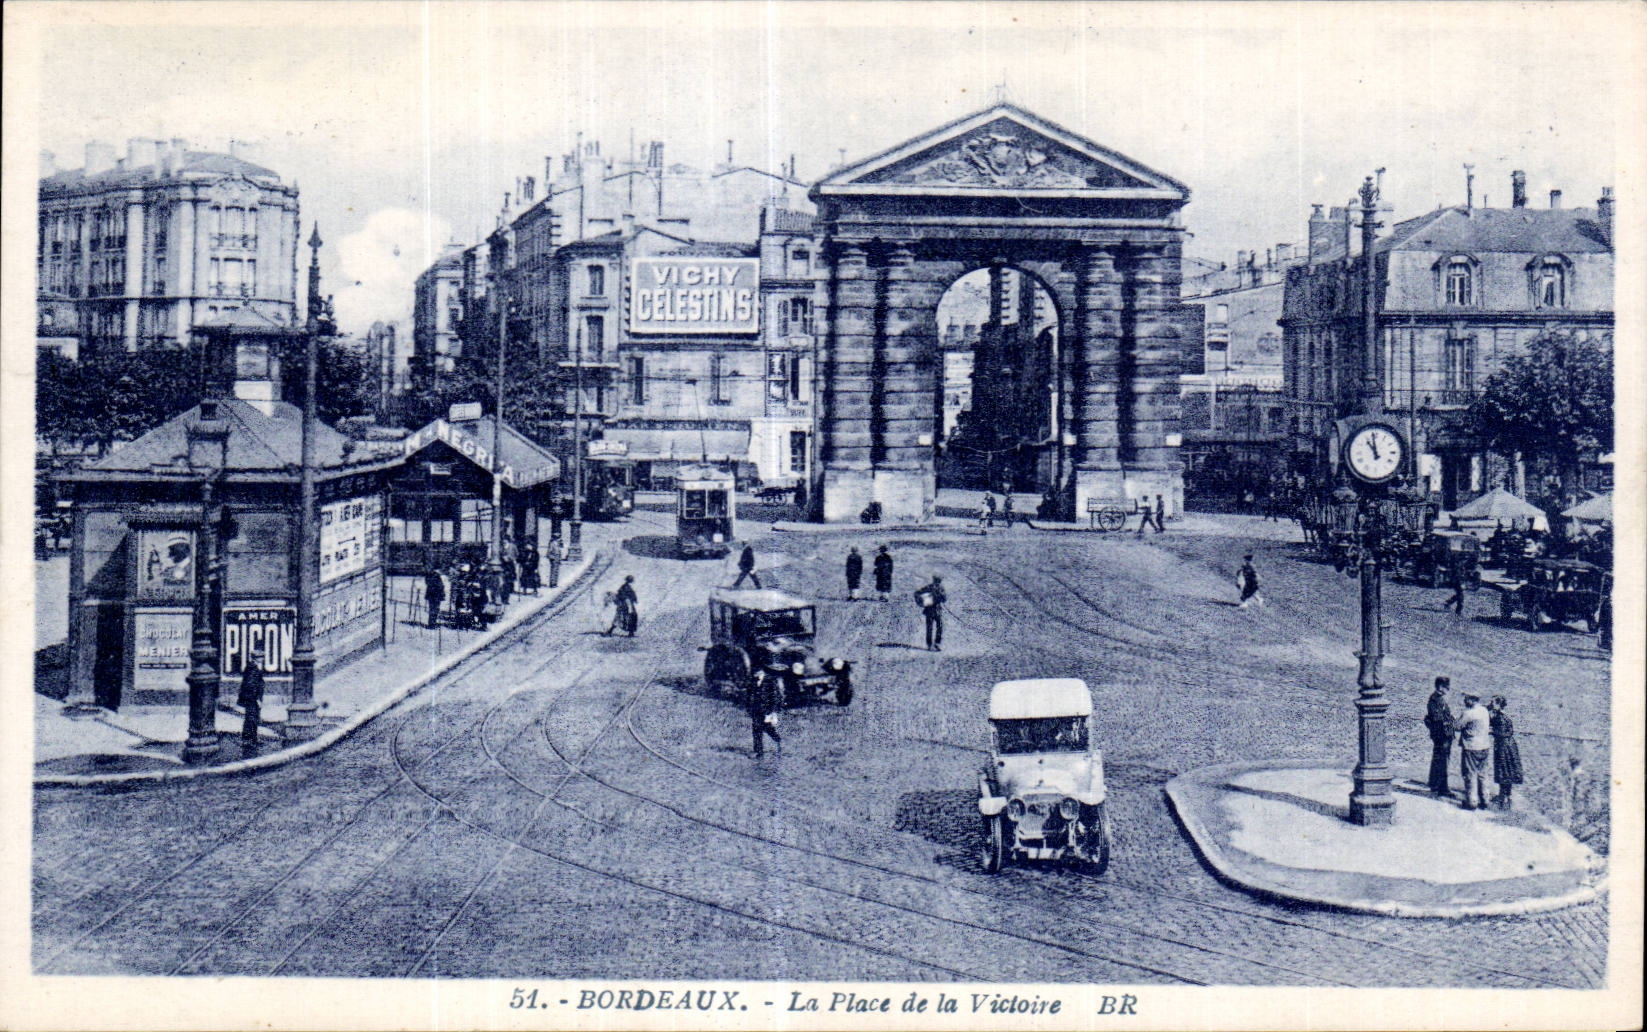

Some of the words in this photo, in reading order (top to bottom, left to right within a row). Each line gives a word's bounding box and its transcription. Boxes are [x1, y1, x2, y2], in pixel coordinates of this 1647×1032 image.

[653, 266, 740, 286] VICHY
[437, 419, 515, 485] NEGRIA
[238, 612, 278, 621] AMER
[138, 646, 190, 659] MENIER
[225, 623, 294, 673] PICON
